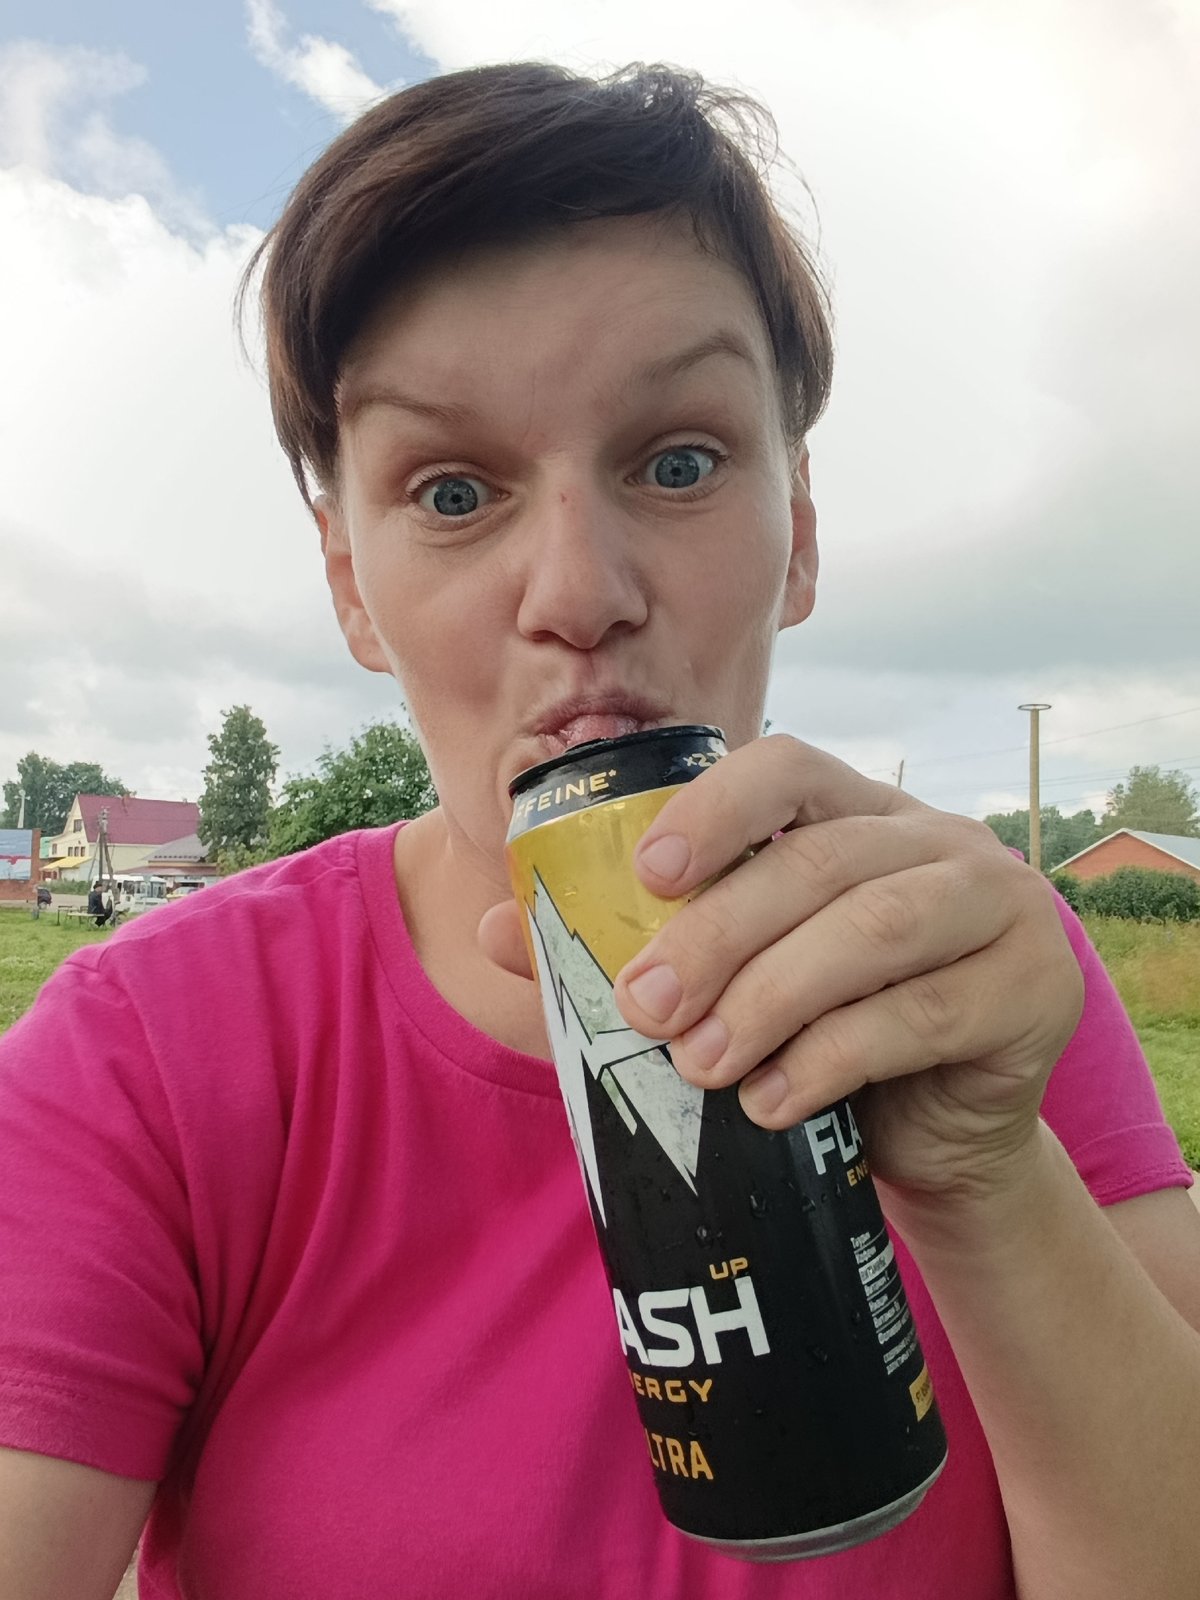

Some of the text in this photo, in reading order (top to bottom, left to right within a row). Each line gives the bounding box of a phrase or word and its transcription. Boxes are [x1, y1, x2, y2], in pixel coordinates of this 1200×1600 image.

[709, 1256, 749, 1280] UP
[612, 1275, 771, 1368] ASH
[628, 1369, 713, 1403] ERGY
